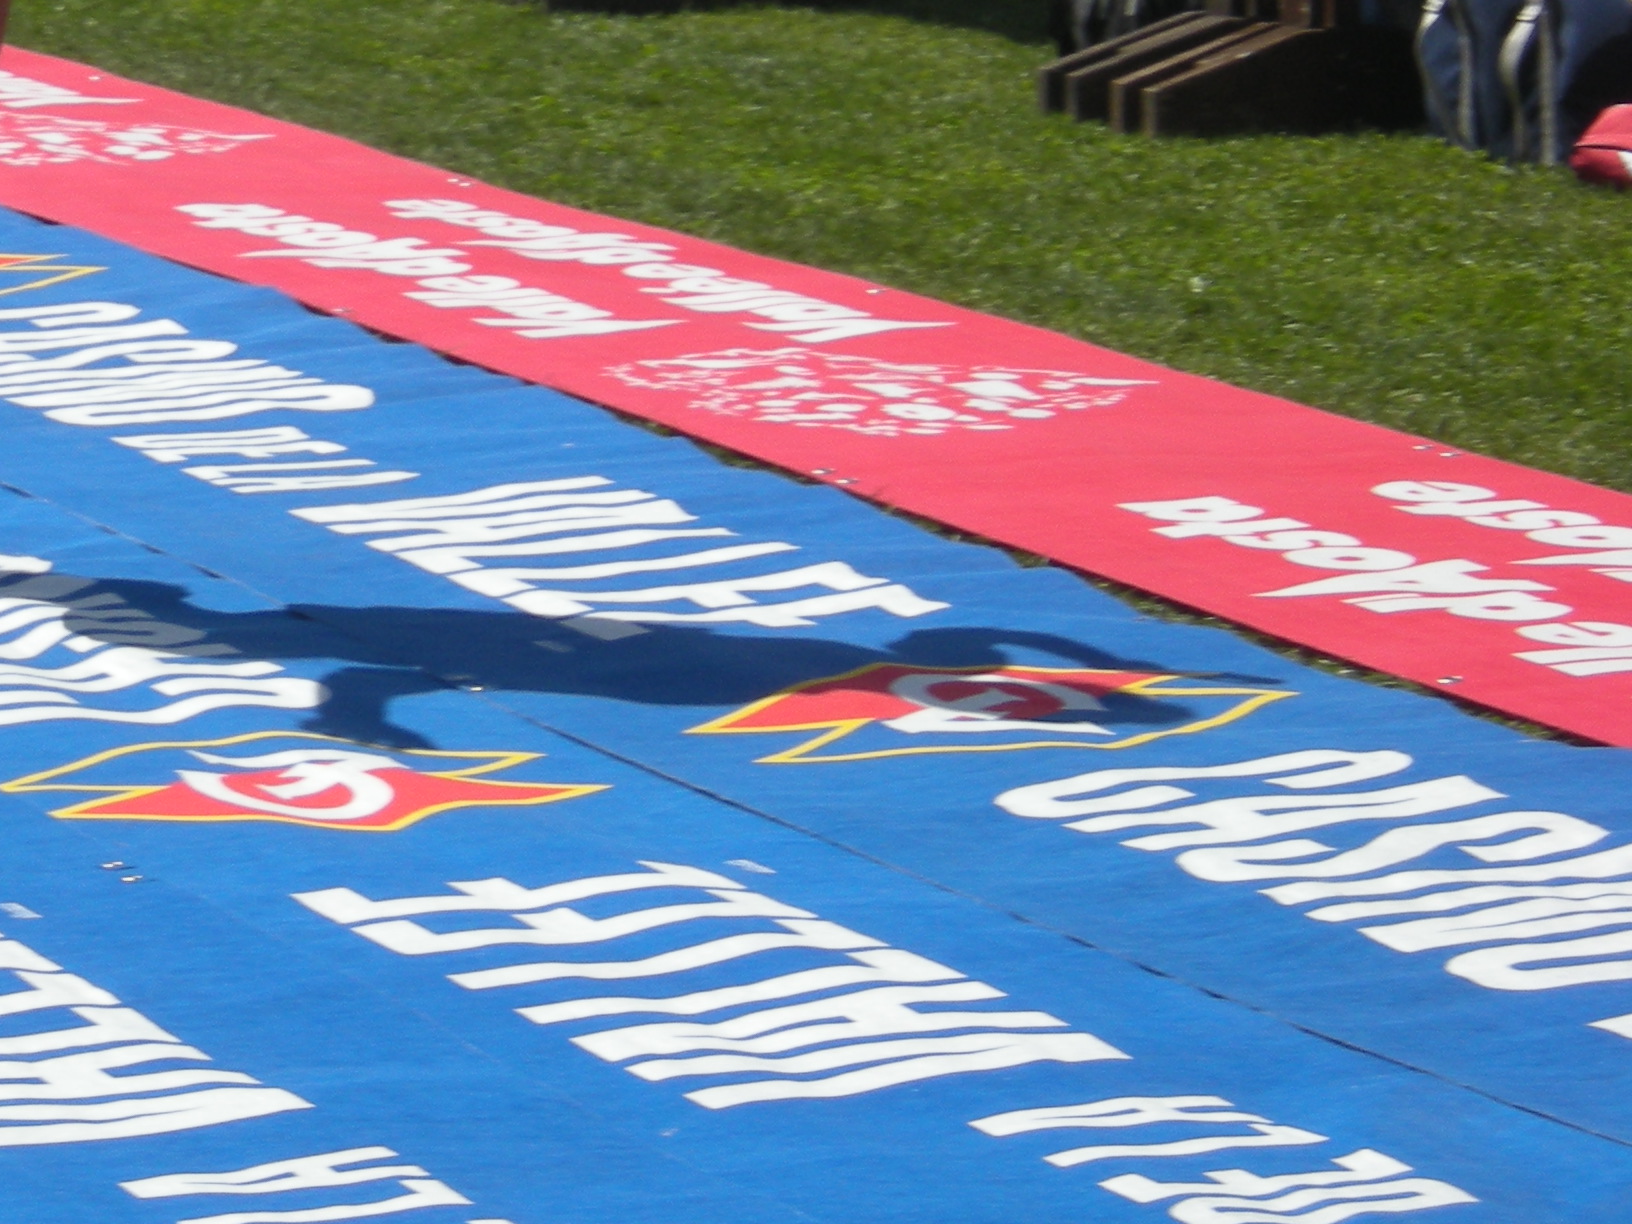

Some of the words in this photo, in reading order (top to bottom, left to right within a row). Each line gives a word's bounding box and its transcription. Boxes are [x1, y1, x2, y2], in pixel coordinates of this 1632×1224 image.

[403, 273, 684, 338] Valle
[111, 426, 347, 463] DE
[181, 459, 420, 493] LA
[290, 475, 952, 640] VALLEE
[291, 861, 1131, 1109] VALLEE
[968, 1096, 1324, 1167] LA
